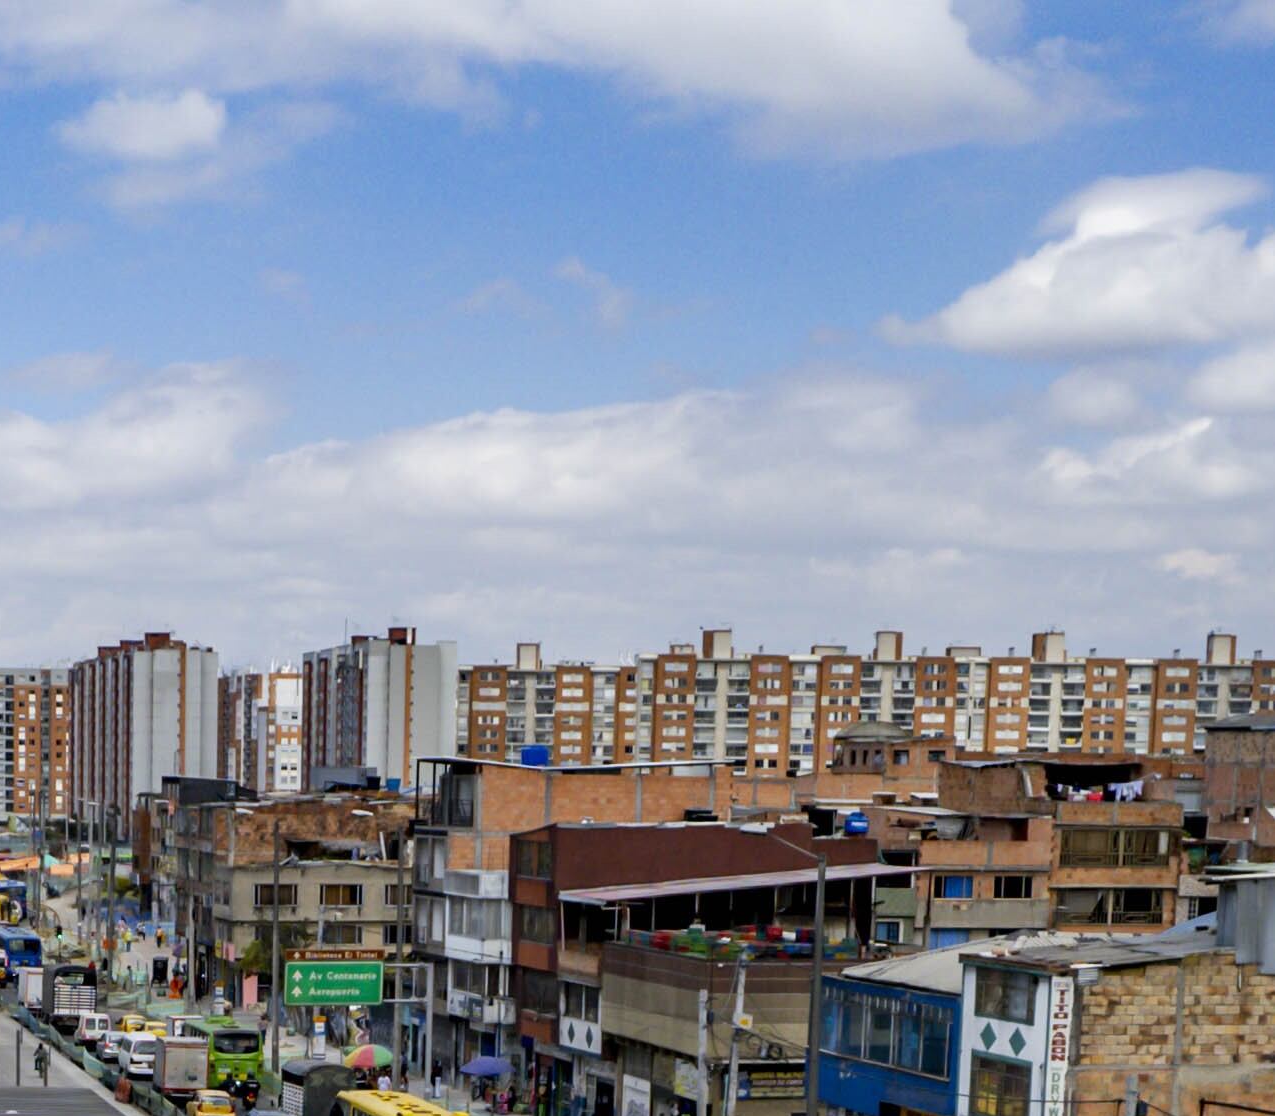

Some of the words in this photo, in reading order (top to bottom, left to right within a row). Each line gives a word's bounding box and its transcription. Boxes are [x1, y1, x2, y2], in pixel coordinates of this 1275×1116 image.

[309, 971, 323, 981] Av
[326, 971, 377, 981] Centenario
[308, 987, 360, 997] Aeropuerto
[1054, 989, 1070, 1019] TITO
